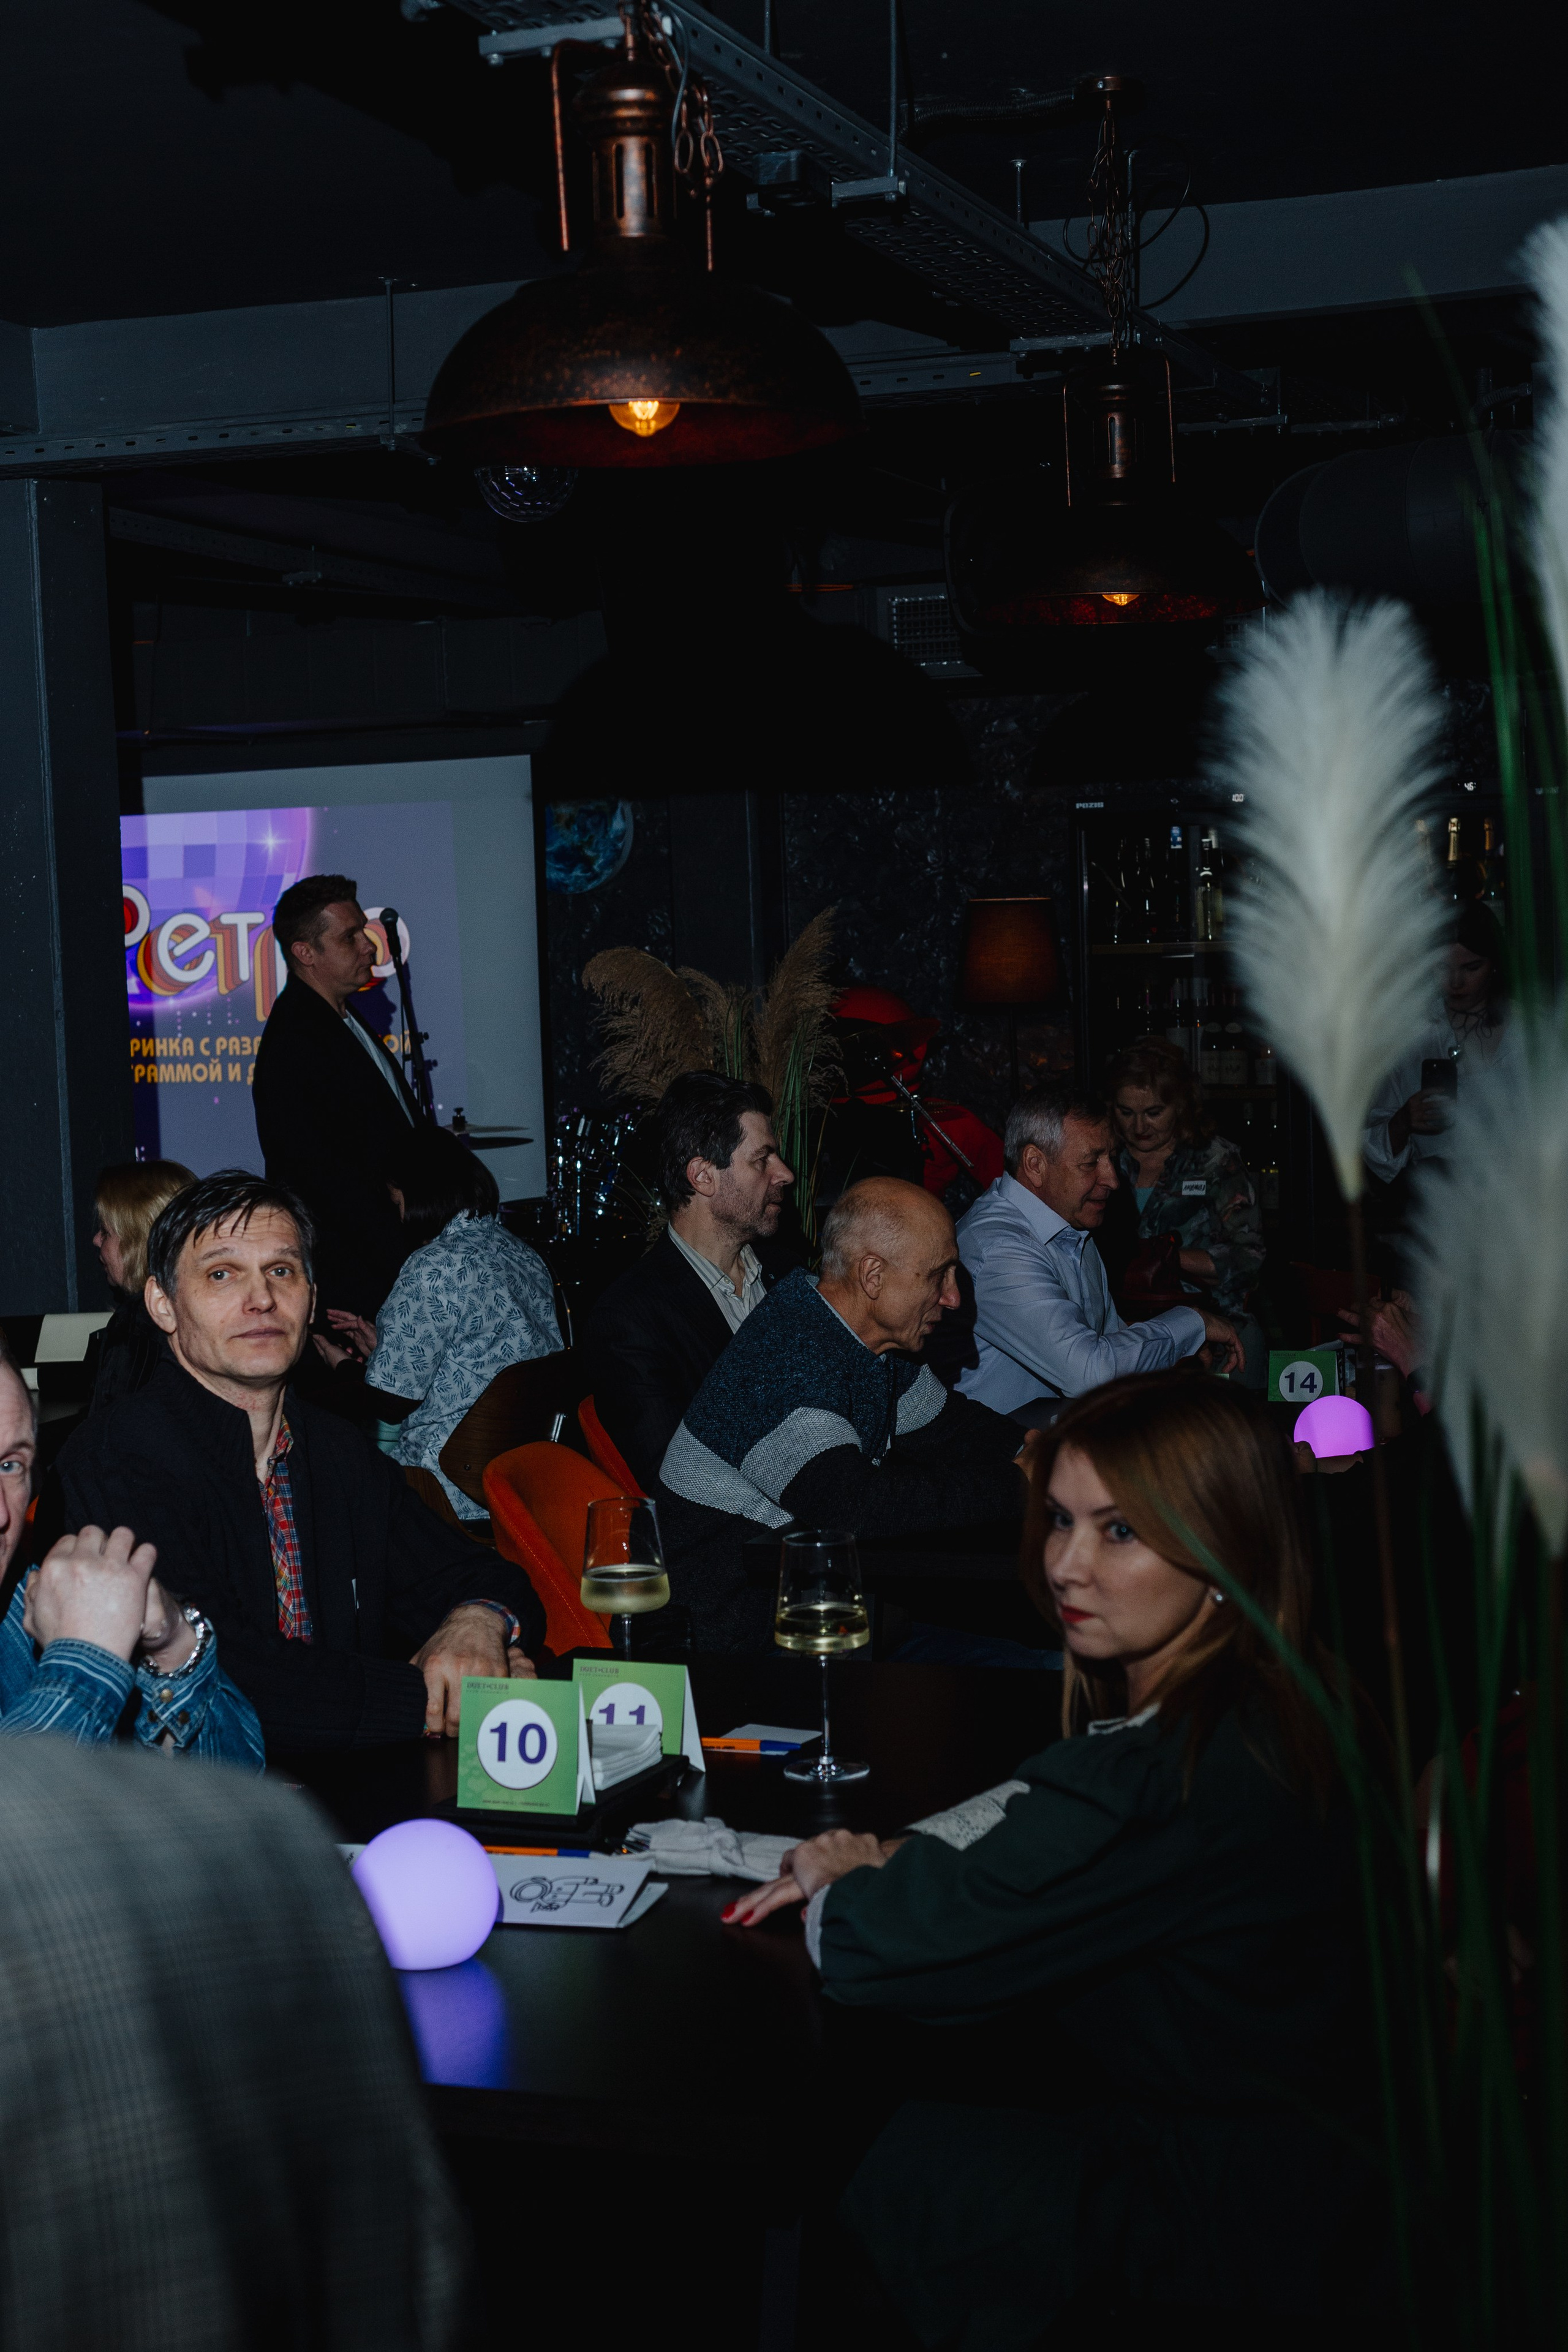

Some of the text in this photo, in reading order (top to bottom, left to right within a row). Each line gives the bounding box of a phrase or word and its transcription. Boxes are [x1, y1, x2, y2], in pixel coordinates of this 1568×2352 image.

[199, 1036, 211, 1057] С
[130, 1058, 223, 1084] РАММОЙ
[227, 1061, 242, 1083] И
[1284, 1371, 1317, 1393] 14
[490, 1722, 547, 1764] 10
